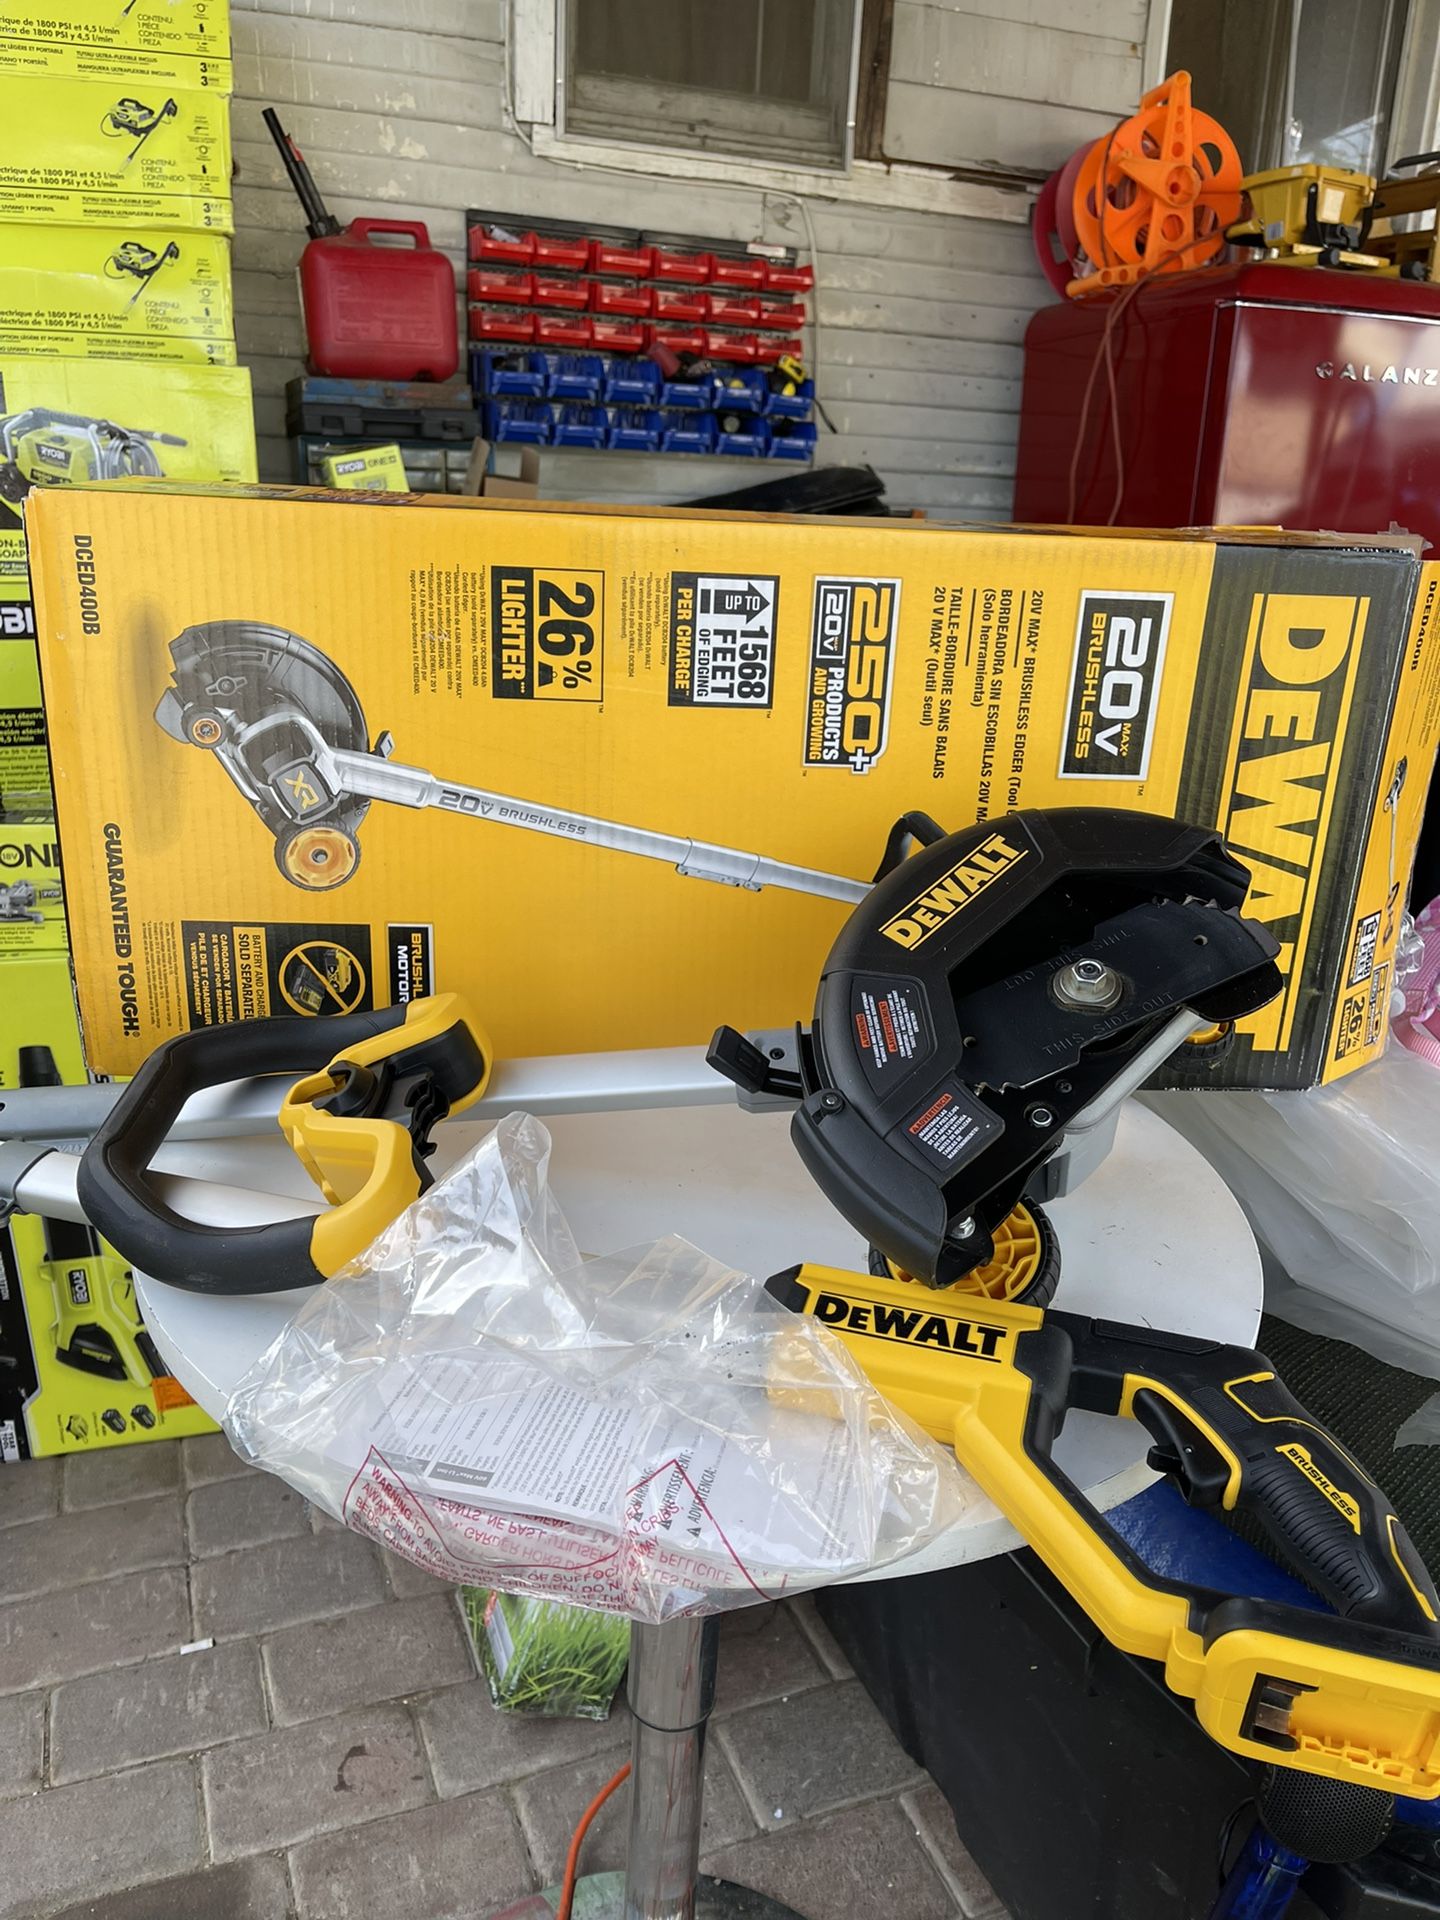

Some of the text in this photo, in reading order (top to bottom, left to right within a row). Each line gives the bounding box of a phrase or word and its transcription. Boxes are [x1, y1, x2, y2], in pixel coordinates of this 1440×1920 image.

[33, 28, 53, 37] 1800
[55, 30, 68, 39] PSI
[36, 19, 56, 29] 1800
[58, 21, 72, 31] PSI
[73, 23, 82, 31] et
[200, 62, 207, 73] 3
[201, 76, 208, 86] 3
[40, 177, 59, 185] 1800
[43, 169, 62, 177] 1800
[203, 203, 211, 213] 3
[1315, 361, 1439, 386] GALANZ
[74, 534, 101, 635] DCED400B
[677, 587, 694, 620] PER
[725, 595, 760, 611] UP TO
[934, 586, 946, 603] 20
[1030, 590, 1043, 615] 20V
[823, 593, 844, 651] 20V
[933, 606, 944, 616] V
[992, 589, 1012, 676] BORDEADORA
[1411, 580, 1438, 672] DCED400B
[538, 579, 595, 689] 26%
[970, 588, 996, 707] (Solo herramienta)
[697, 628, 711, 697] OF EDGING
[711, 628, 738, 699] FEET
[737, 625, 769, 699] 1568
[924, 658, 939, 692] (Outil
[933, 587, 963, 779] TAILLE-BORDURE SANS BALAIS
[989, 679, 1002, 700] SIN
[1016, 657, 1036, 730] BRUSHLESS
[1074, 612, 1107, 759] BRUSHLESS
[1094, 616, 1153, 756] 20V
[809, 666, 828, 760] AND GROWING
[822, 667, 846, 760] PRODUCTS
[919, 696, 934, 727] seul)
[981, 704, 1000, 777] ESCOBILLAS
[1011, 734, 1026, 773] EDGER
[284, 770, 319, 810] XR
[438, 788, 494, 815] 20V
[499, 806, 587, 835] BRUSHLESS
[978, 781, 990, 803] 20V
[1007, 776, 1021, 806] (Tool
[103, 822, 132, 958] GUARANTEED
[220, 933, 231, 981] CARGADOR
[238, 933, 251, 960] SOLD
[252, 934, 264, 970] BATTERY
[189, 941, 202, 1015] VENDUS SÉPARÉMENT
[198, 932, 212, 1024] PILE DE ET CHARGEUR
[210, 933, 225, 1024] SE VENDEN POR SEPARADO
[254, 971, 264, 988] AND
[397, 945, 409, 1003] MOTOR
[857, 1014, 869, 1041] WARNING
[1043, 992, 1174, 1056] THIS SIDE OUT
[914, 1092, 950, 1130] ADVERTENCIA
[71, 1271, 89, 1303] RYOBI
[687, 1466, 718, 1524] ADVERTENCIA:
[1287, 1447, 1356, 1517] BRUSHLESS
